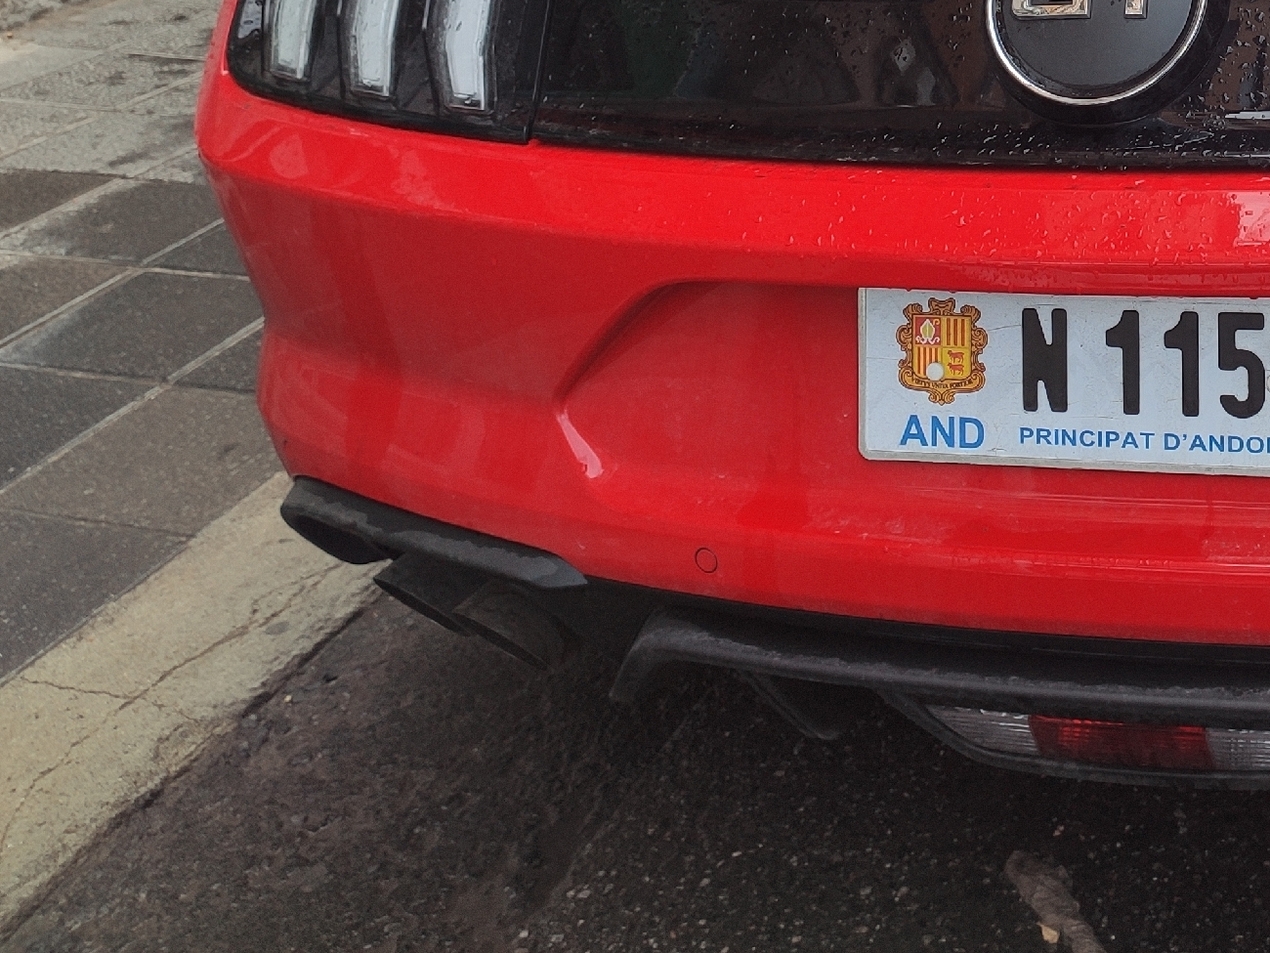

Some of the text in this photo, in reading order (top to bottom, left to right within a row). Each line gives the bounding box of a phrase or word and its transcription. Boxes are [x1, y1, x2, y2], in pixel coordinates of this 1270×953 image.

[1021, 307, 1069, 413] N
[899, 414, 985, 449] AND
[1019, 426, 1155, 451] PRINCIPAT
